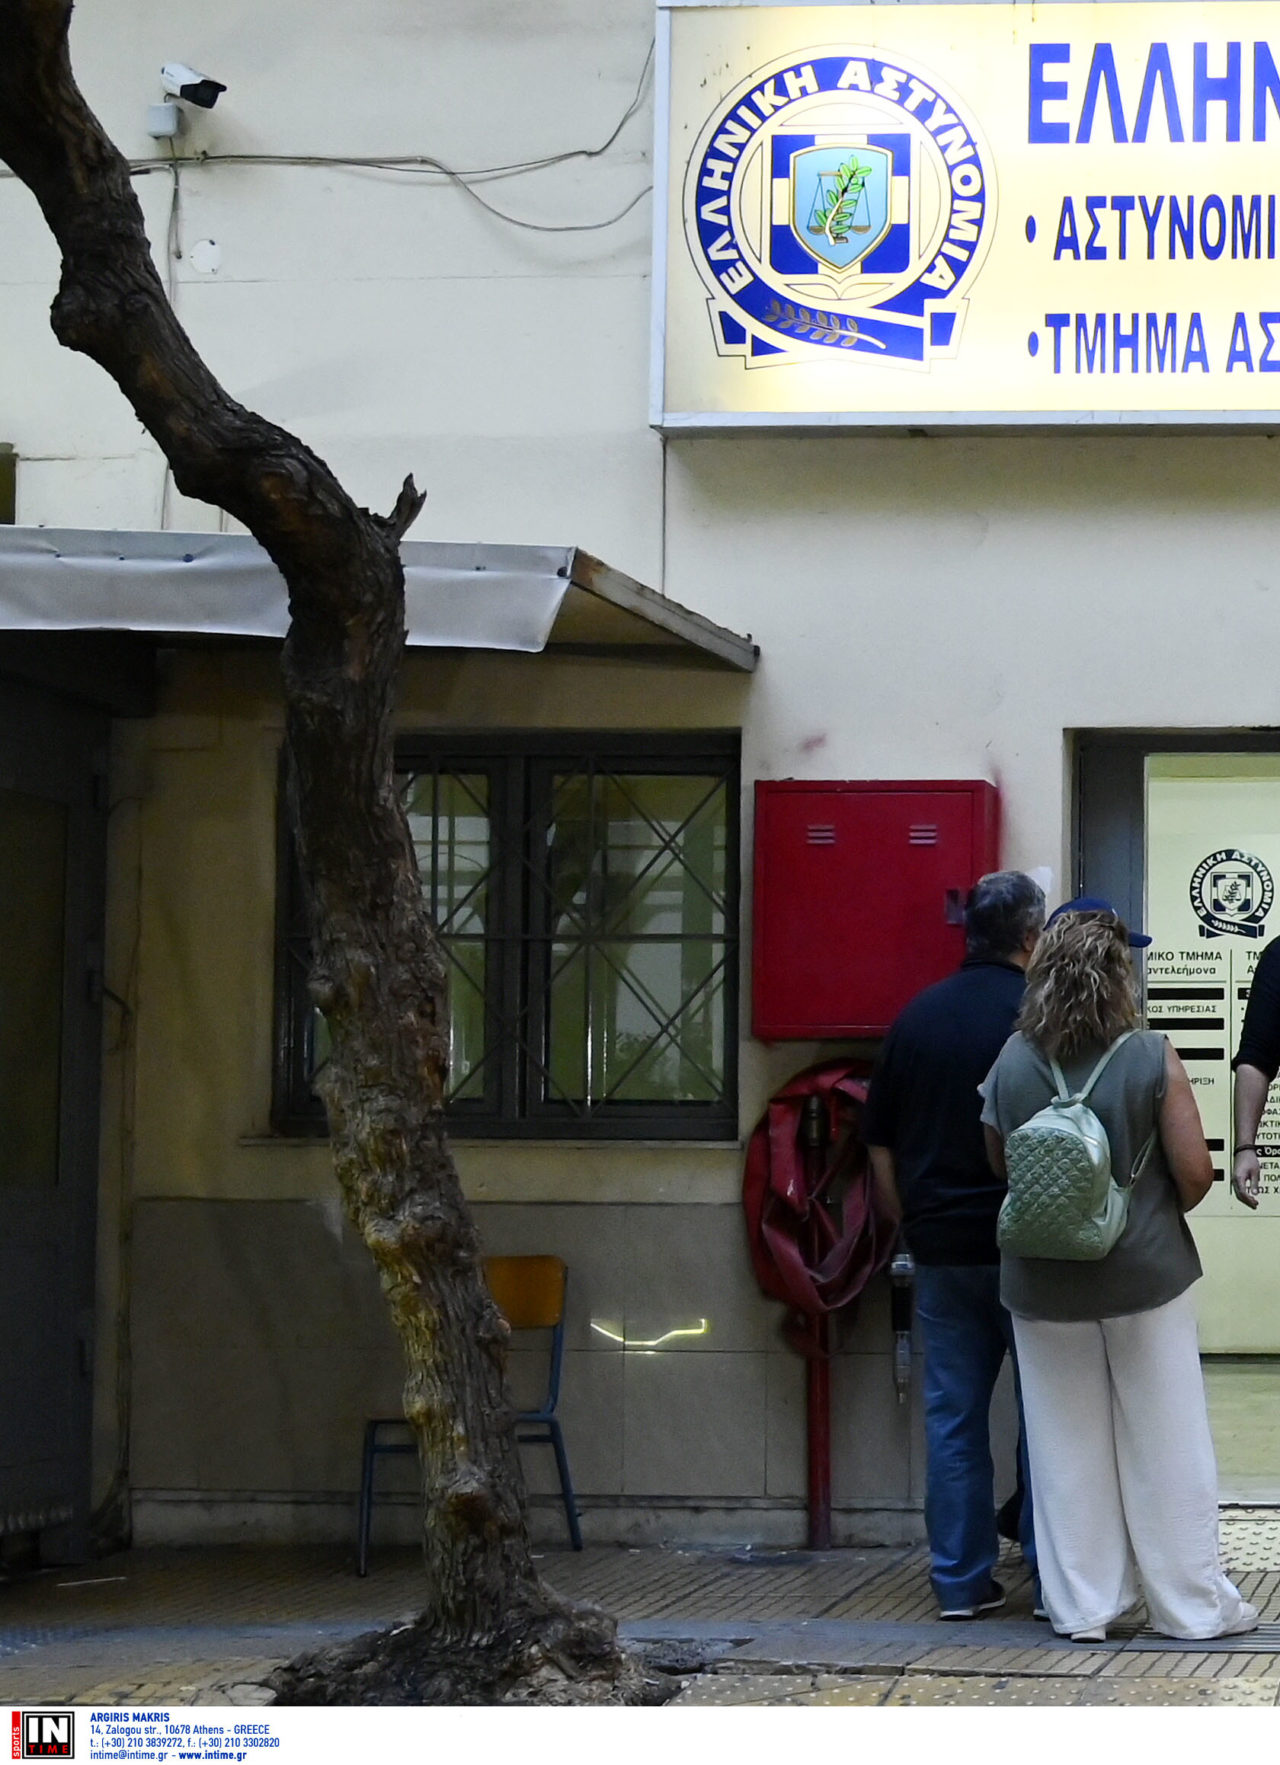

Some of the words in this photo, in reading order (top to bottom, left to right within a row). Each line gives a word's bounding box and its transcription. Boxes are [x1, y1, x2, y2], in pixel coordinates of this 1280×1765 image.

[696, 62, 820, 296] ΕΛΛΗΝΙΚΗ
[836, 59, 987, 293] ΑΣΤΥΝΟΜΙΑ
[1045, 311, 1210, 375] ΤΜΗΜΑ
[1191, 852, 1227, 918] ΕΛΛΗΝΙΚΗ
[1231, 851, 1274, 918] ΑΣΤΥΝΟΜΙΑ
[1178, 951, 1223, 961] ΤΜΗΜΑ
[1167, 1004, 1217, 1013] ΥΠΗΡΕΣΙΑΣ
